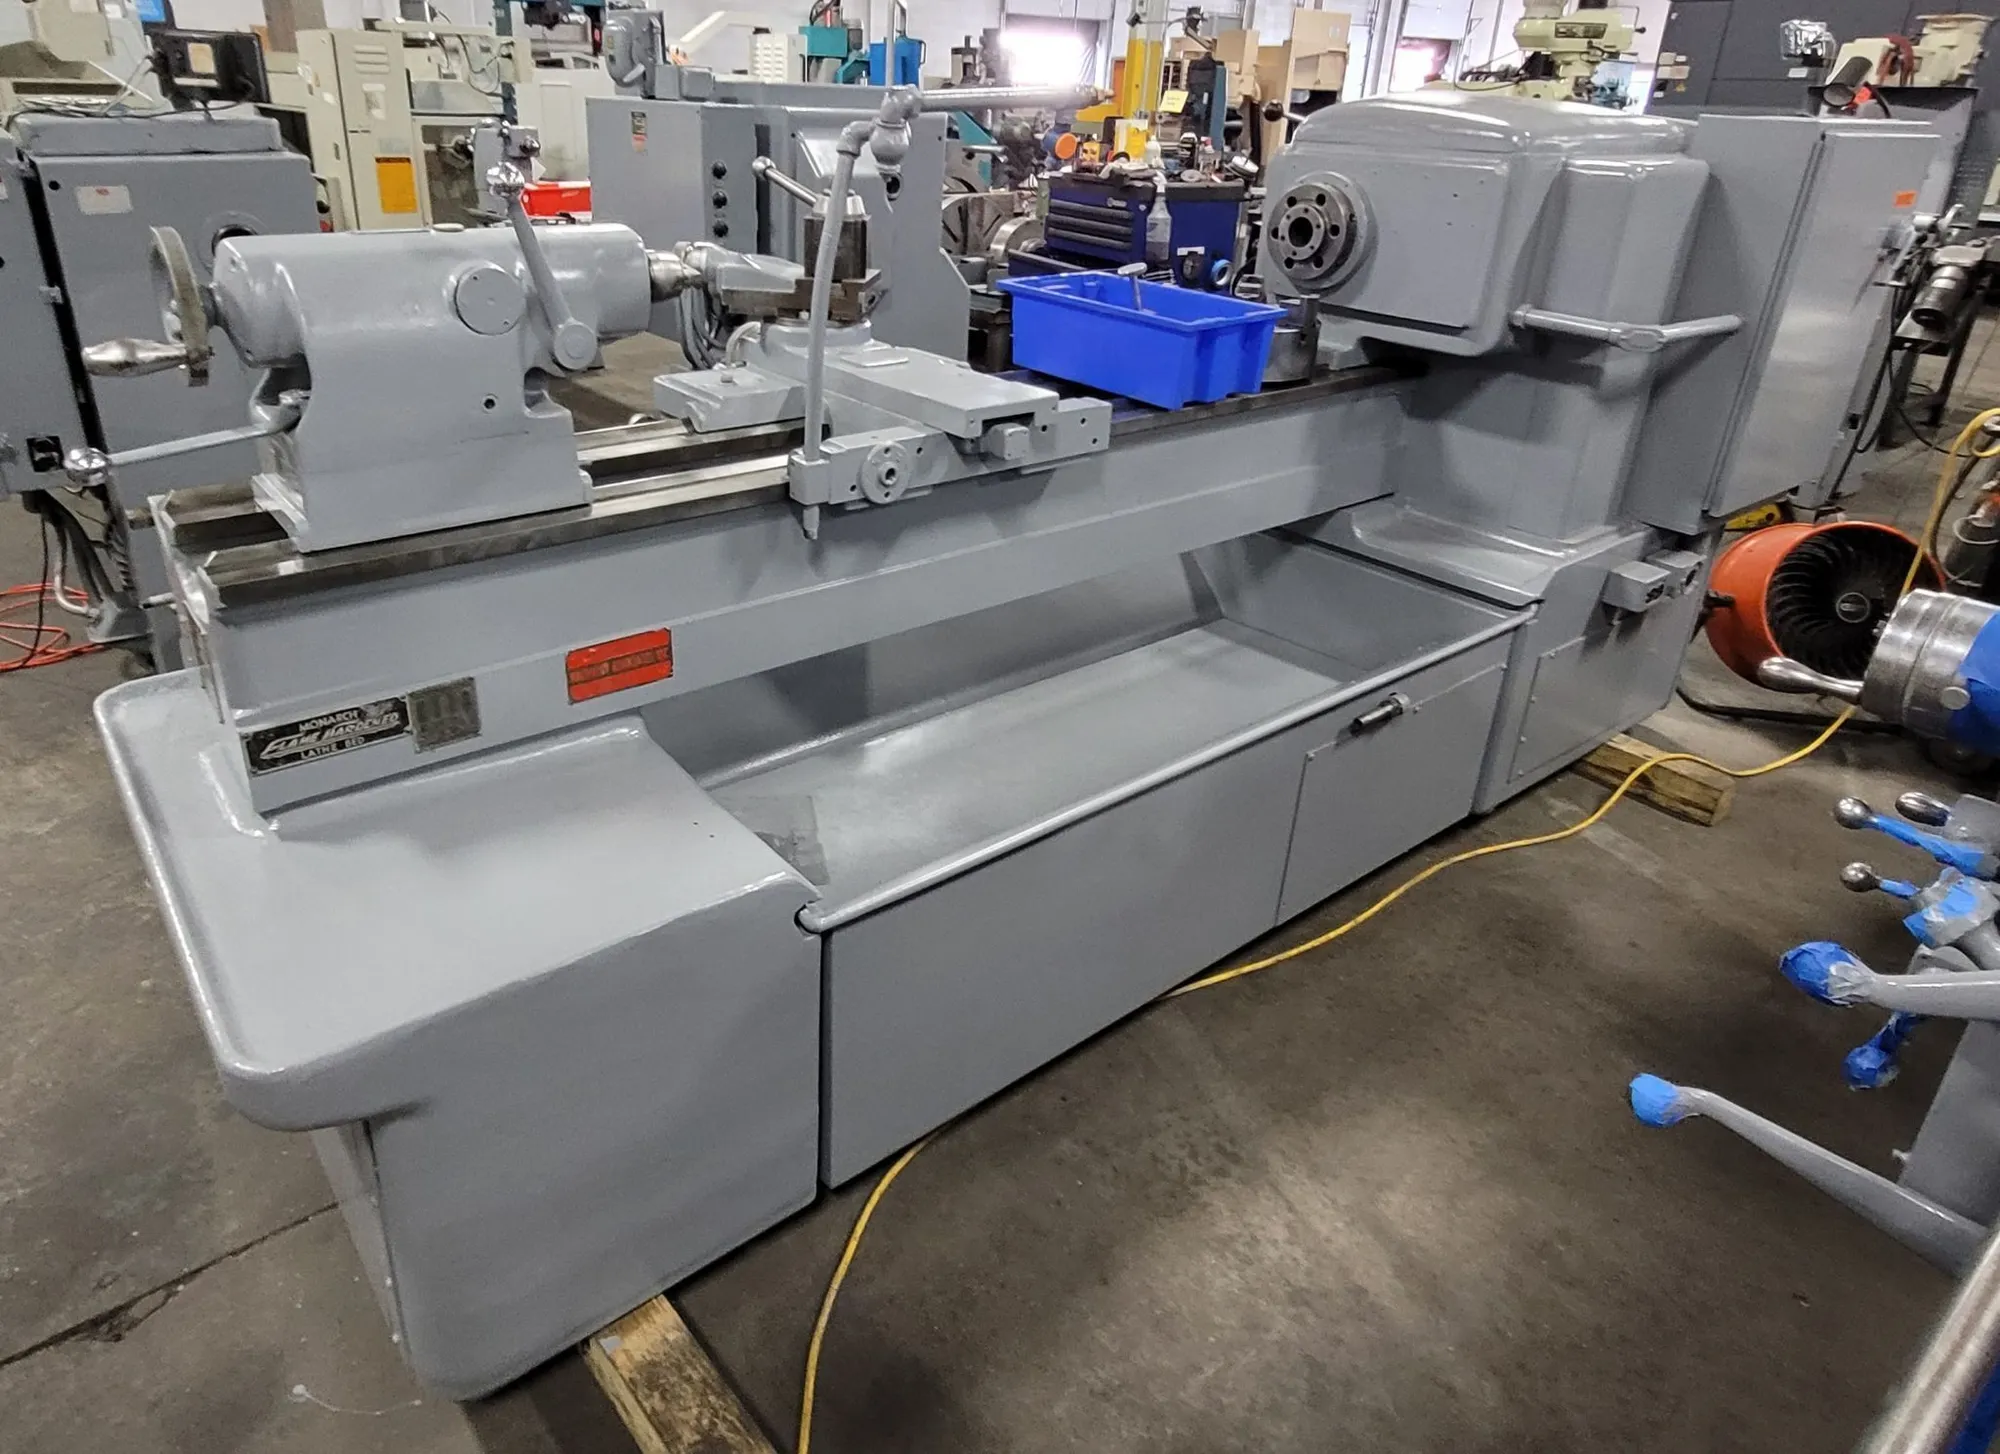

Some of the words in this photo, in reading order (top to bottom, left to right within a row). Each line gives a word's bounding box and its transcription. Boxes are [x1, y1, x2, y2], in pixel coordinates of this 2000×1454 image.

[299, 709, 359, 731] MONARCH
[261, 732, 321, 759] FLAME
[321, 711, 400, 741] HARDENED
[300, 744, 338, 760] LATHE
[344, 735, 365, 749] BED
